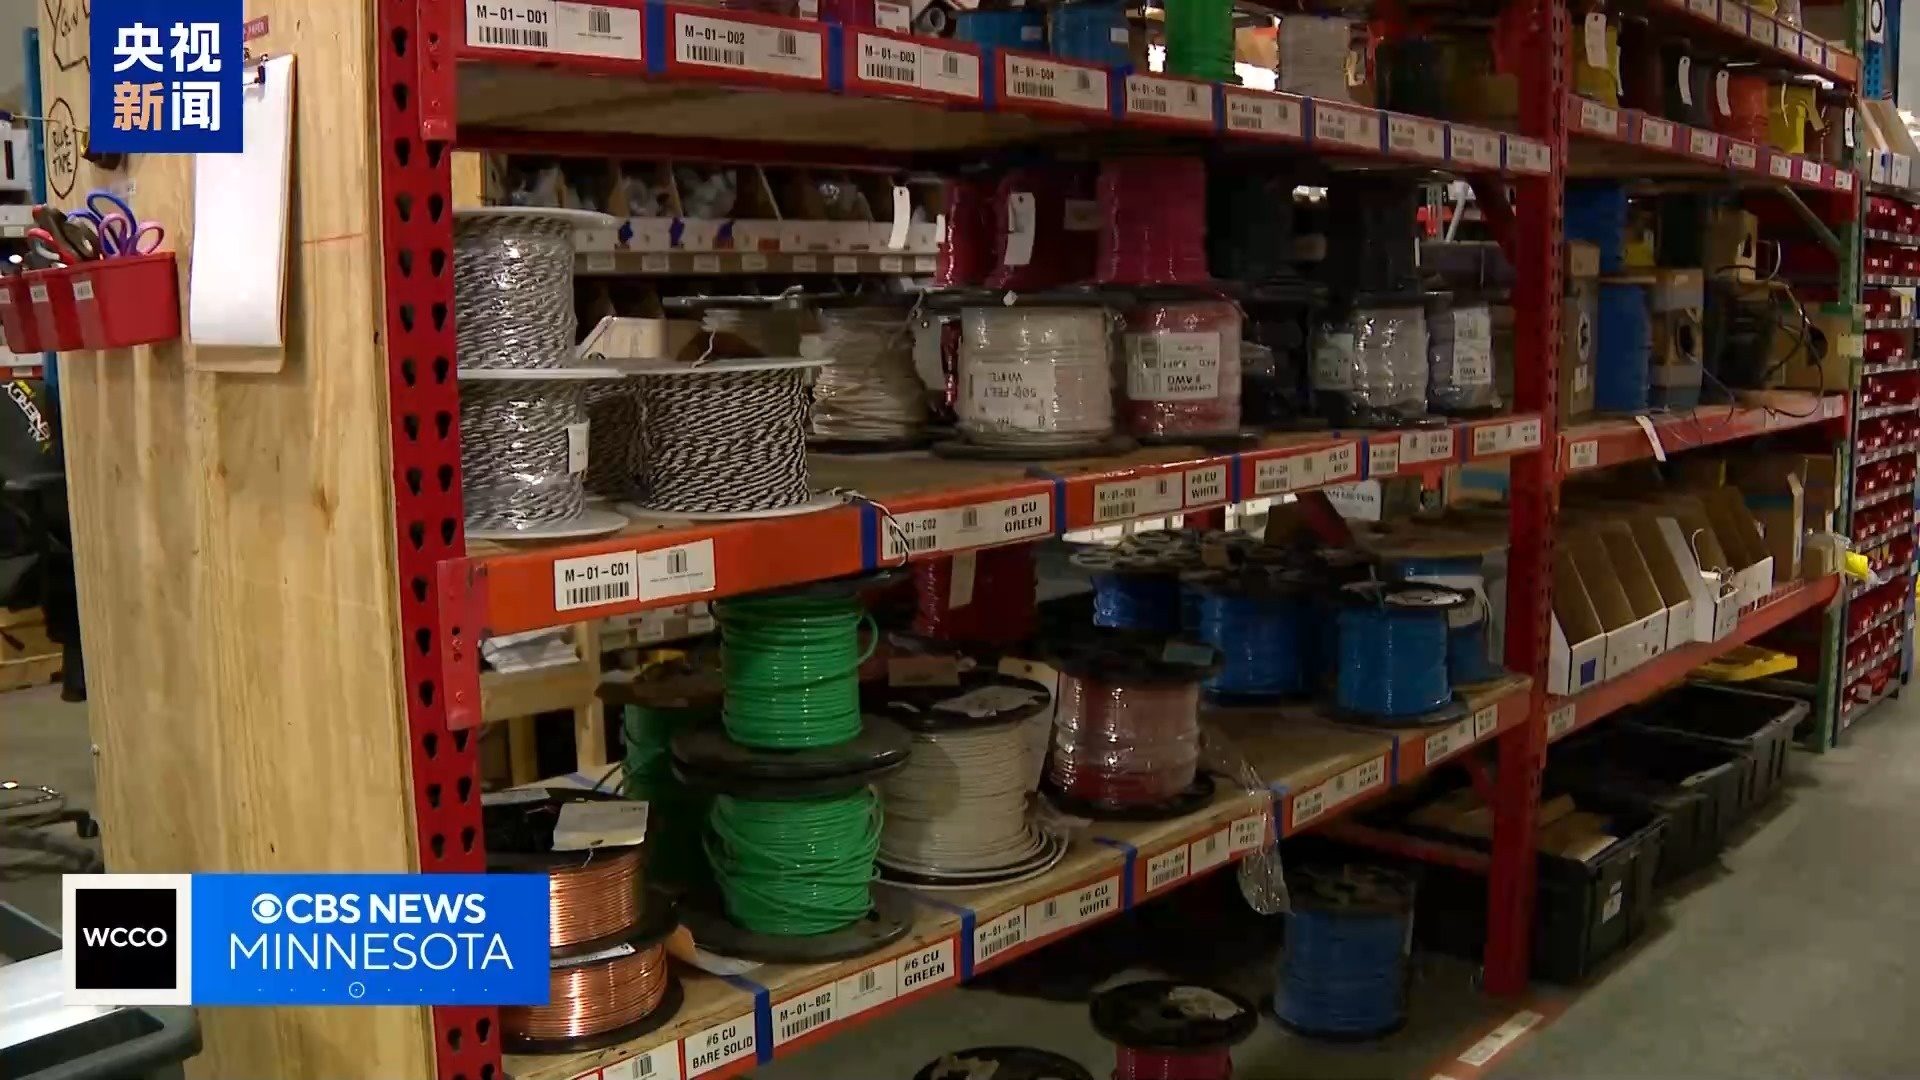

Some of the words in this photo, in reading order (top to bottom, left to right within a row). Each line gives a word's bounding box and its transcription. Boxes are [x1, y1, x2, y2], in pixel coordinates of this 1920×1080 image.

[476, 5, 548, 24] M-01-D01
[685, 25, 745, 45] M-01-D02
[865, 43, 916, 64] M-01-D03
[1021, 501, 1037, 515] CU
[889, 518, 937, 537] M01-C02
[1004, 515, 1043, 534] GREEN
[565, 562, 629, 583] M-01-C01
[1094, 883, 1108, 898] CU
[1079, 897, 1112, 917] WHITE
[904, 958, 919, 973] #6
[922, 950, 940, 965] CU
[904, 962, 945, 987] GREEN
[780, 992, 831, 1022] M-01-B02
[706, 1033, 719, 1048] #6
[722, 1025, 736, 1040] CU
[692, 1050, 720, 1069] BARE
[723, 1036, 753, 1057] SOLID
